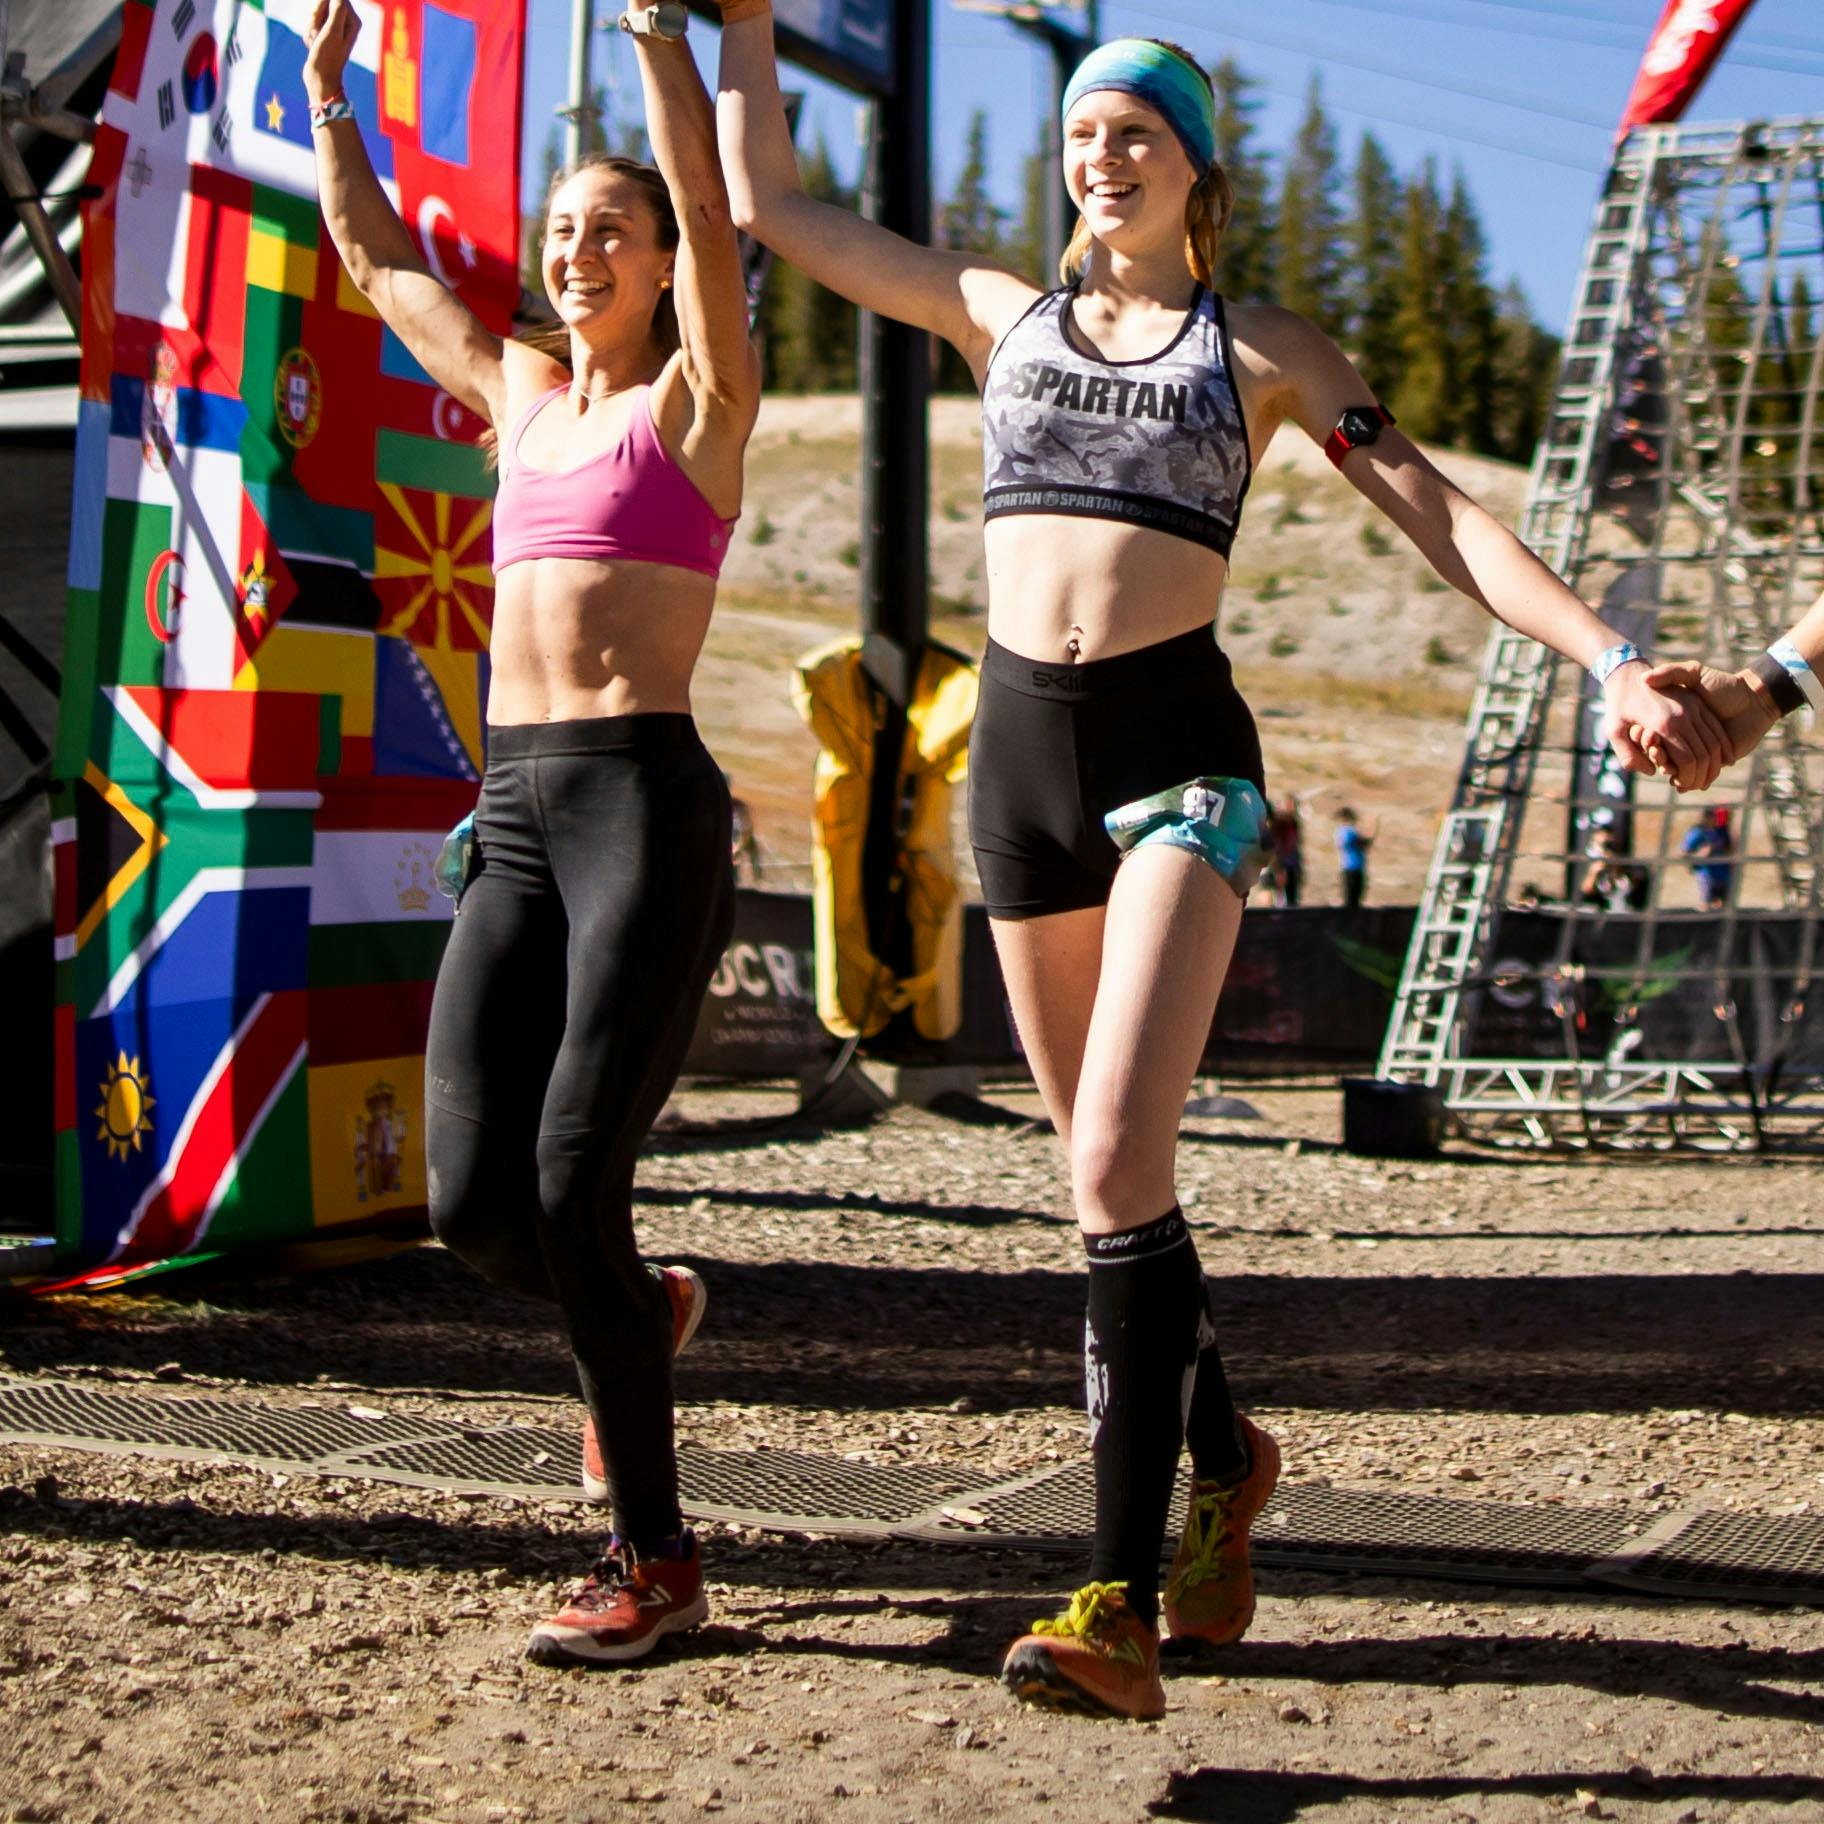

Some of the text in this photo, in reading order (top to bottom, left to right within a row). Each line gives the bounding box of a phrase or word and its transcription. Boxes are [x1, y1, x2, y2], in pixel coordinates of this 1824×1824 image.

[1010, 363, 1188, 423] SPARTAN
[993, 491, 1042, 509] SPARTAN
[1059, 494, 1123, 514] SPARTAN
[1097, 1227, 1161, 1251] CRAFT
